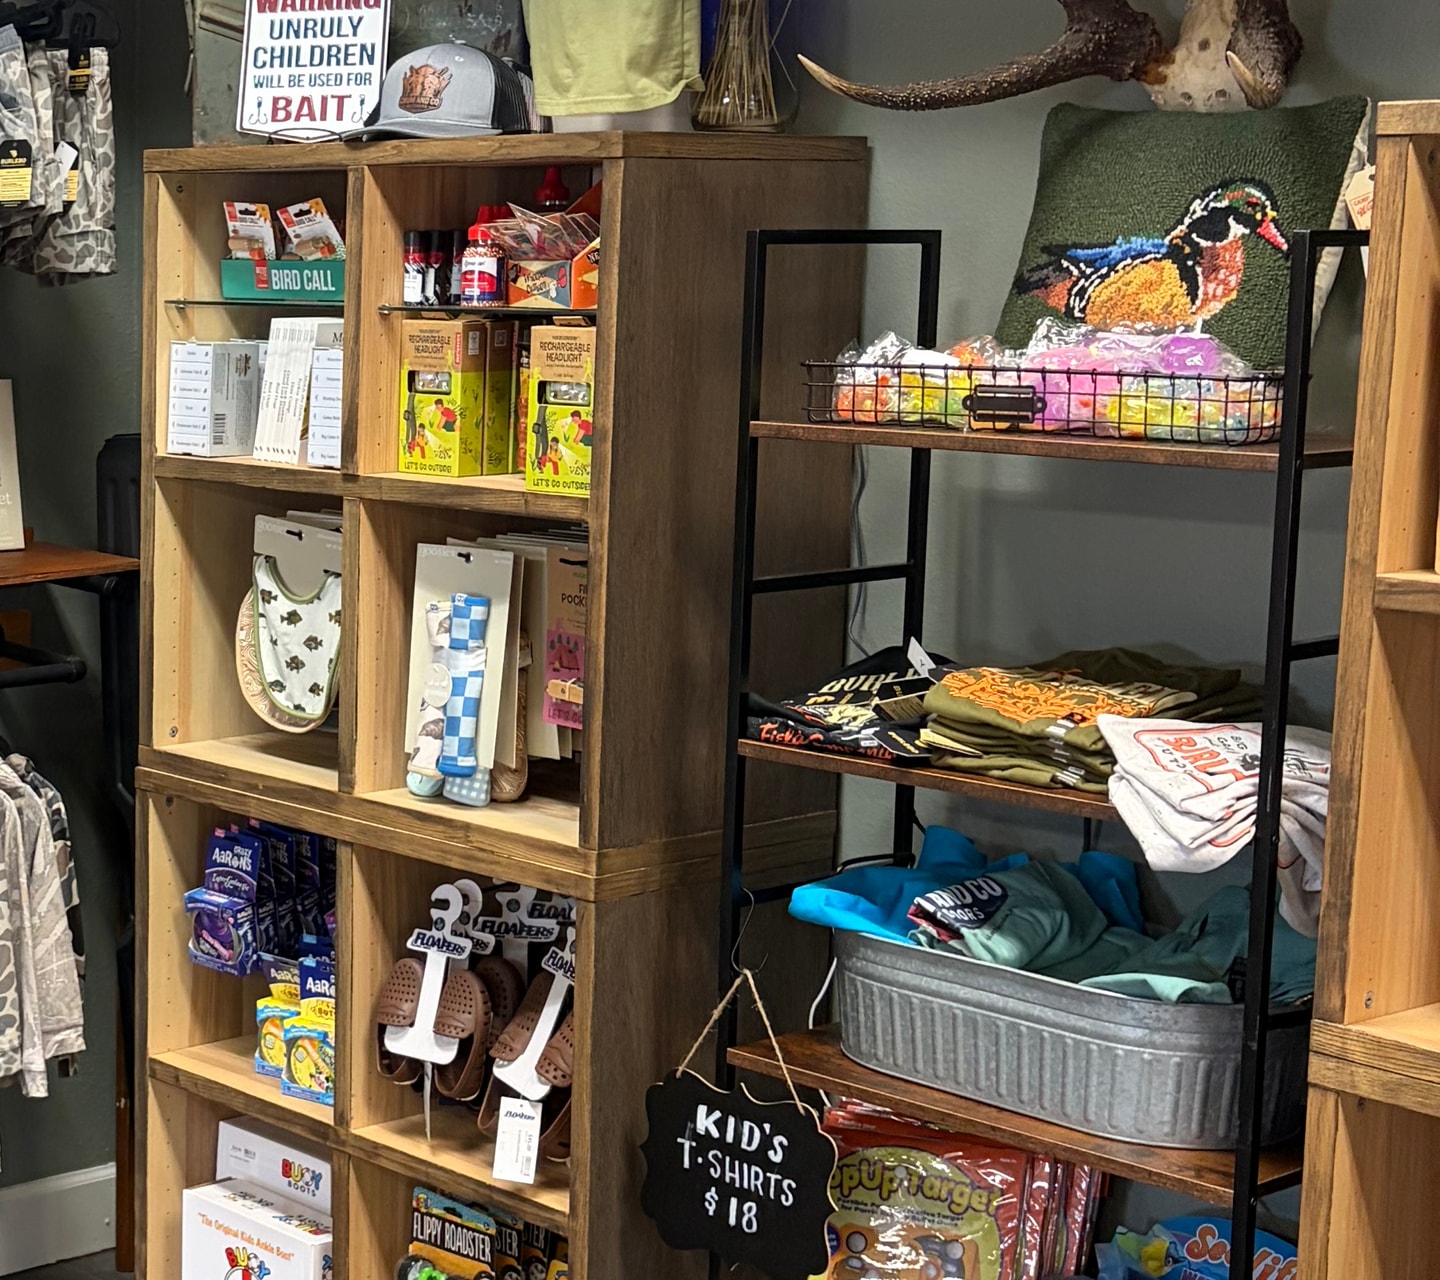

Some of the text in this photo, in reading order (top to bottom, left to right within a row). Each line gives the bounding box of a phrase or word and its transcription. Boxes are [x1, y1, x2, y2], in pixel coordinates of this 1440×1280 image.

[268, 15, 364, 40] UNRULY
[252, 42, 377, 69] CHILDREN
[253, 72, 373, 89] WILL BE USED FOR
[270, 94, 352, 123] BAIT
[270, 269, 336, 291] BIRD CALL
[408, 334, 452, 346] RECHARGEABLE
[414, 344, 445, 355] HEADLIGHT
[539, 340, 592, 354] RECHARGEABLE
[545, 352, 583, 364] HEADLIGHT
[404, 461, 419, 470] LET'S
[532, 477, 561, 489] LET'S GO
[925, 876, 1003, 908] AND CO
[480, 919, 555, 938] FLOAFERS
[412, 931, 467, 955] FLOAFERS
[695, 1104, 789, 1164] KID'S
[281, 1157, 323, 1191] BUOY
[287, 1179, 317, 1197] BOOTS
[831, 1161, 899, 1202] opUp
[906, 1169, 1003, 1218] Target
[728, 1196, 758, 1234] 18
[213, 1220, 275, 1254] Original Kids Ankle
[412, 1212, 492, 1263] FLIPPY ROADSTER
[224, 1246, 271, 1280] BUOY
